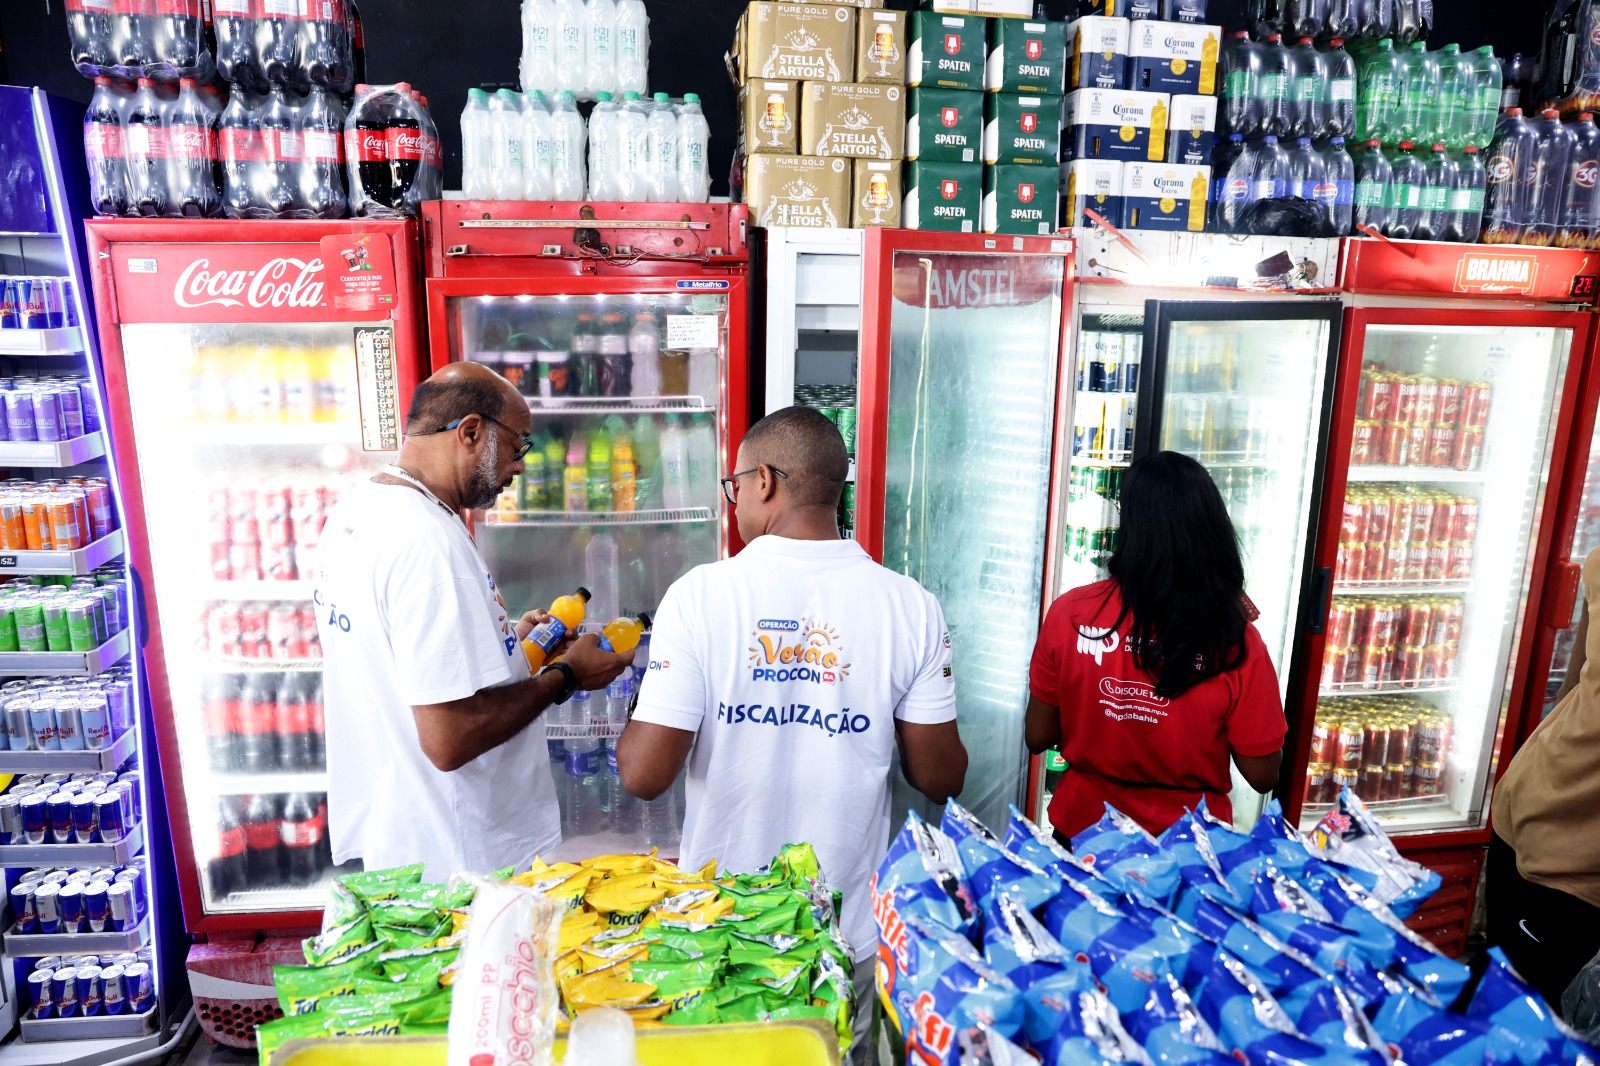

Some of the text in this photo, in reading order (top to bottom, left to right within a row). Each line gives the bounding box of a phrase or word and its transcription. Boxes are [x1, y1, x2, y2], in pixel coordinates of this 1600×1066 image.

[778, 5, 828, 15] PURE GOLD
[1164, 37, 1195, 48] Corona
[1171, 47, 1189, 55] Extra
[779, 54, 825, 67] STELLA
[938, 58, 970, 72] SPATEN
[778, 66, 825, 78] ARTOIS
[1018, 64, 1050, 77] SPATEN
[1113, 104, 1144, 115] Corona
[832, 132, 877, 144] STELLA
[934, 134, 967, 145] SPATEN
[1014, 138, 1045, 149] SPATEN
[831, 144, 877, 155] ARTOIS
[776, 157, 798, 165] PURE
[1153, 177, 1184, 188] Corona
[933, 206, 966, 217] SPATEN
[1011, 209, 1042, 219] SPATEN
[1466, 257, 1530, 283] BRAHMA
[174, 258, 325, 308] Coca-Cola
[925, 269, 1020, 306] AMSTEL
[759, 620, 798, 630] OPERAÇÃO
[758, 634, 840, 668] Verão
[752, 667, 835, 685] PROCON BA
[1114, 686, 1148, 698] DISQUE
[717, 701, 871, 737] FISCALIZAÇÃO
[1104, 708, 1159, 724] @mpdabahia
[88, 727, 100, 735] Red
[482, 963, 496, 984] PP
[503, 939, 537, 1066] scchio
